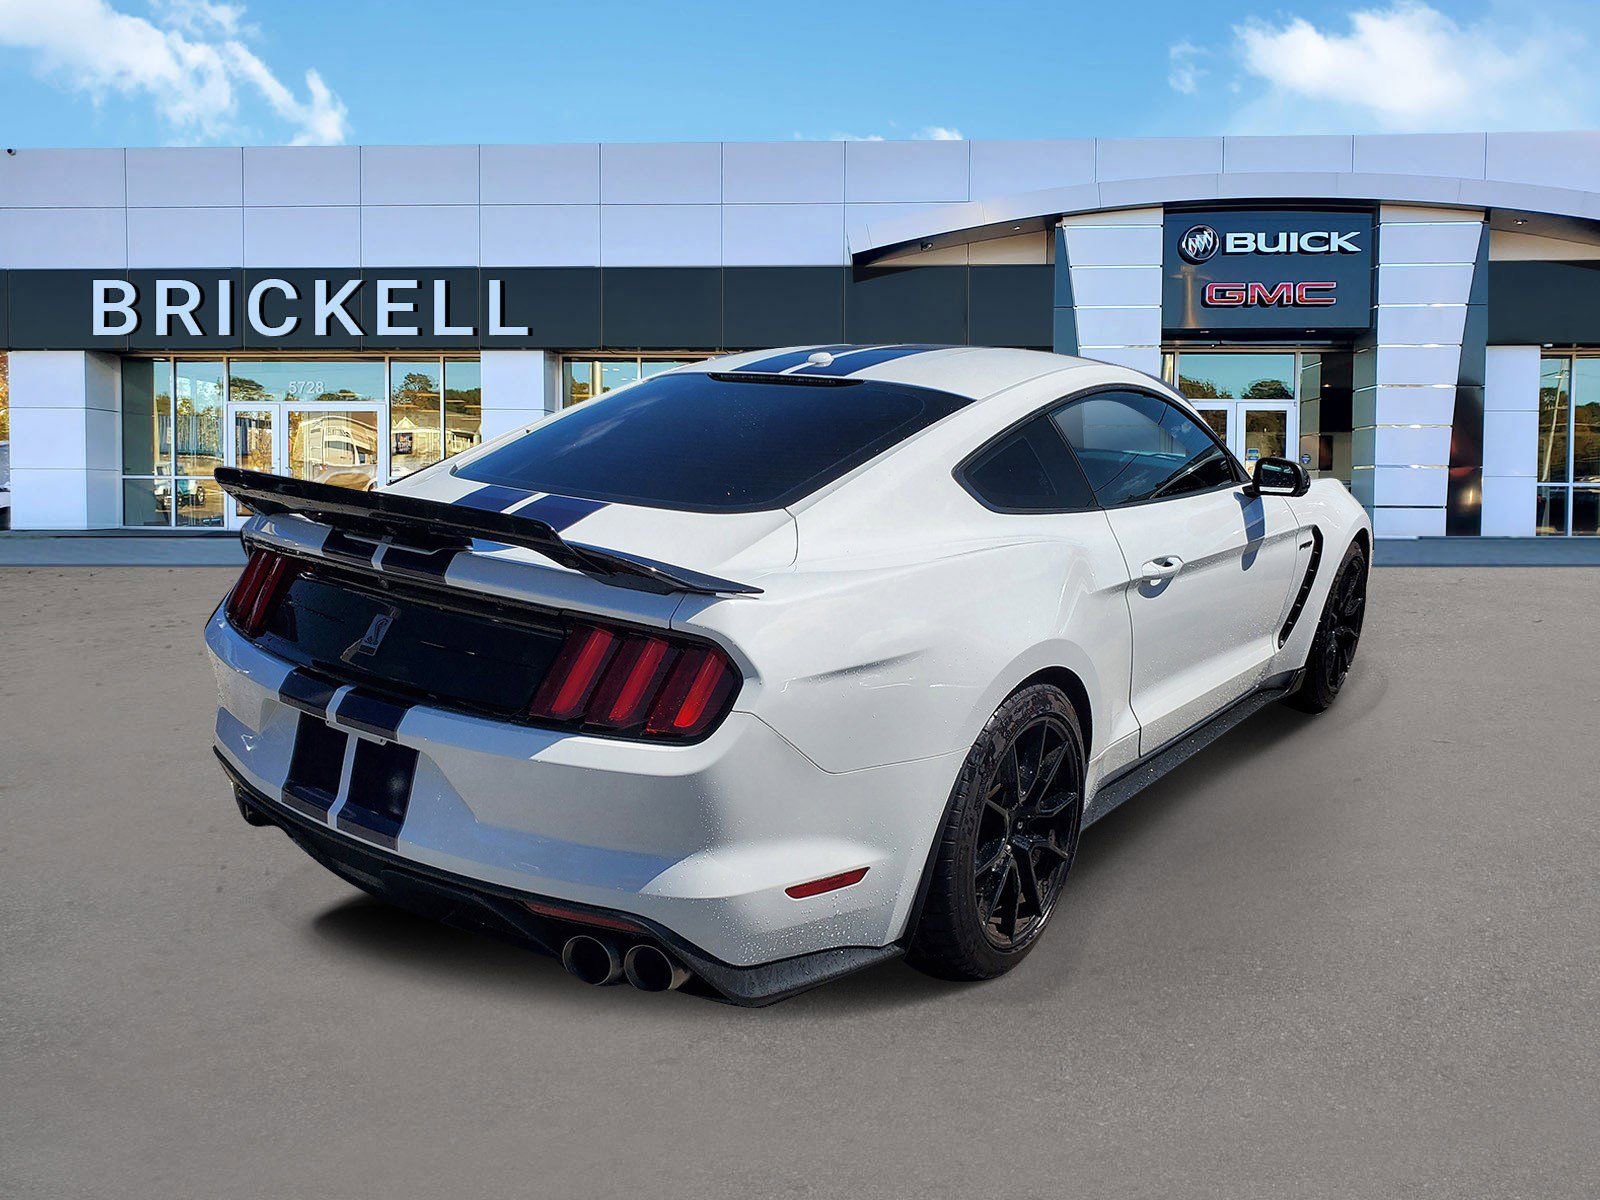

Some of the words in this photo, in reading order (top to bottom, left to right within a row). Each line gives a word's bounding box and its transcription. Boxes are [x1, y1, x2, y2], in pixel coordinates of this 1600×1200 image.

[1225, 231, 1362, 253] BUICK
[1204, 281, 1337, 306] GMC
[91, 278, 531, 337] BRICKELL
[288, 380, 325, 394] 5728
